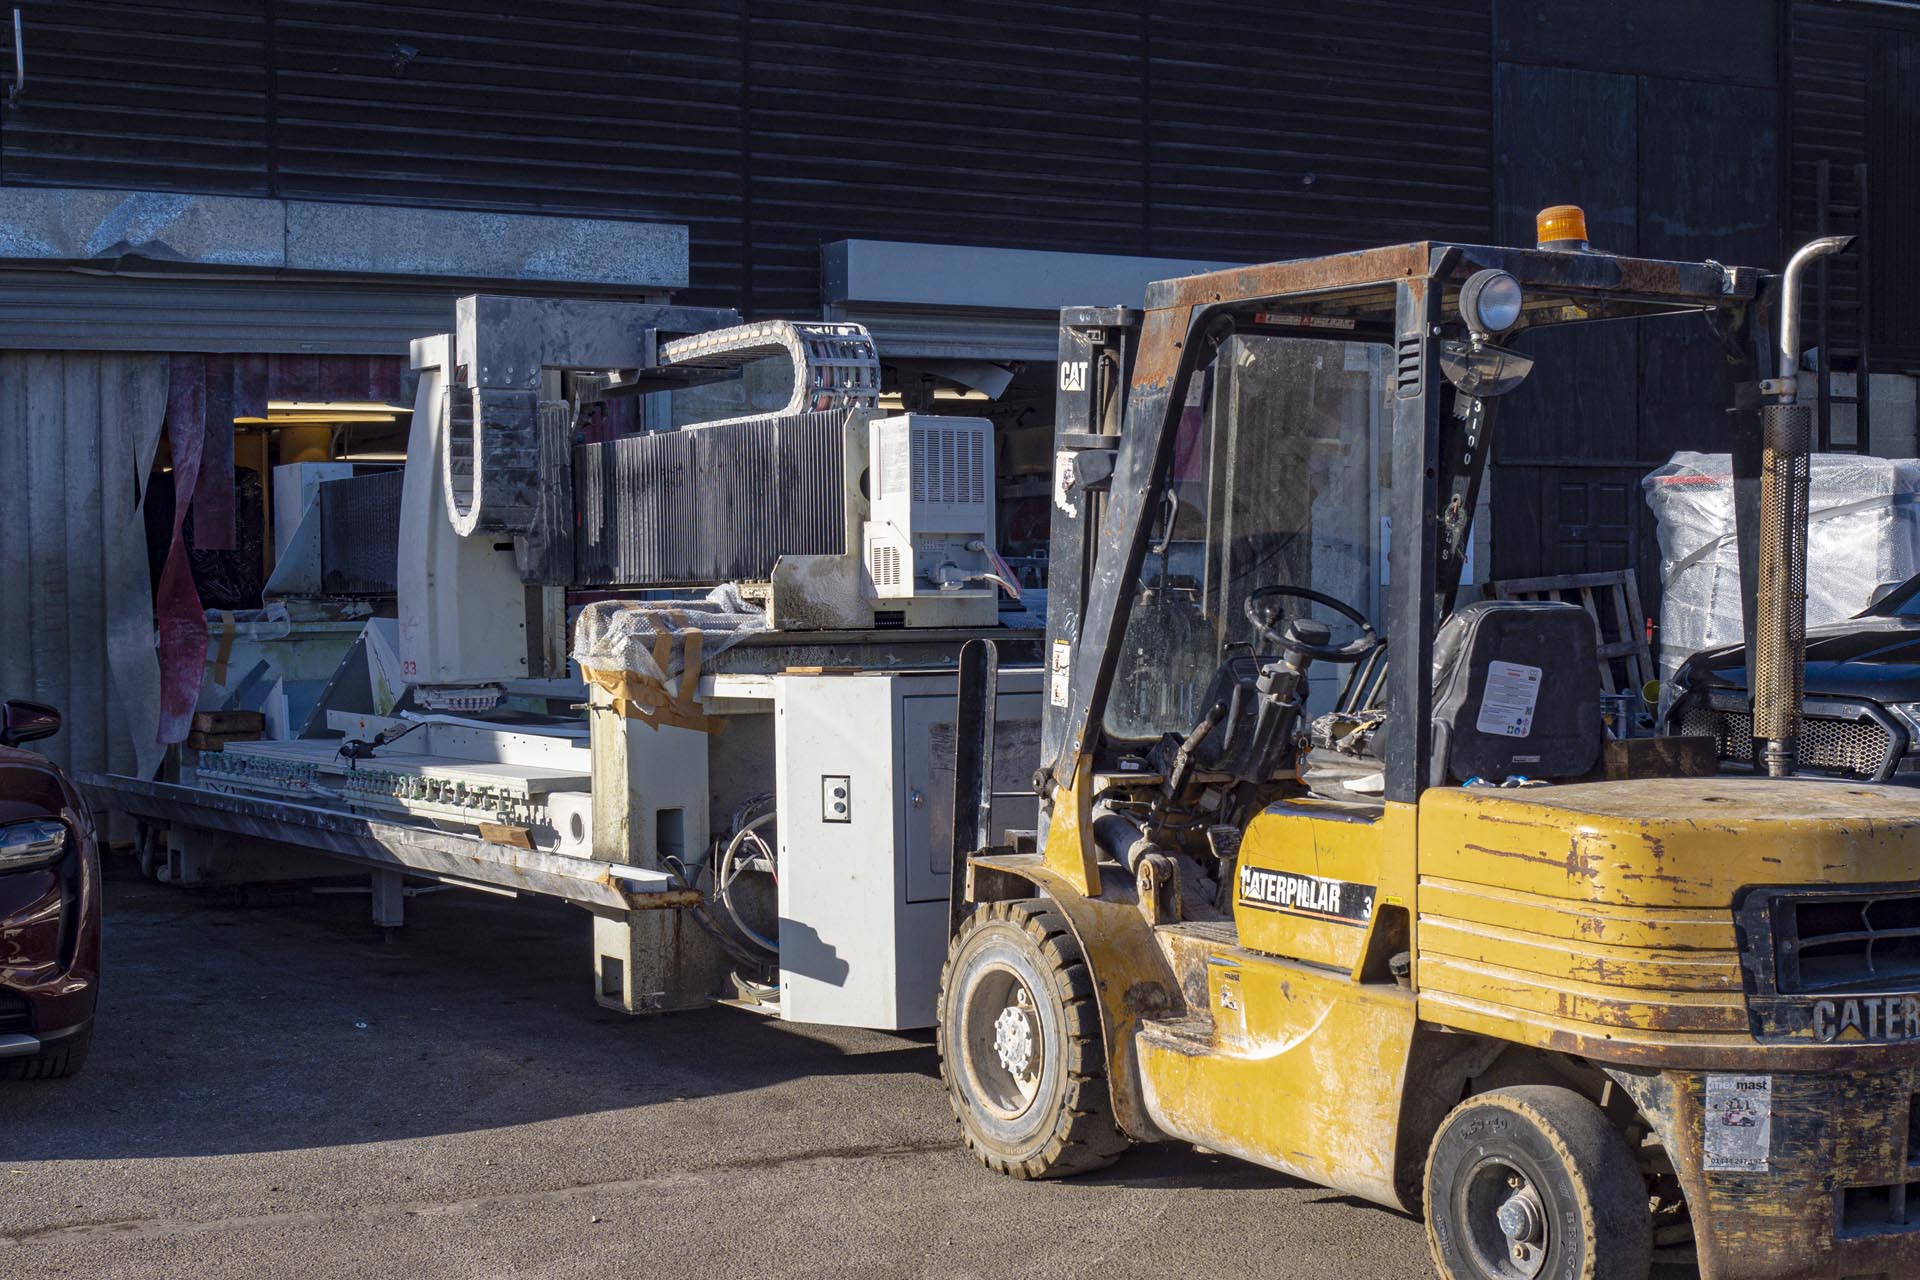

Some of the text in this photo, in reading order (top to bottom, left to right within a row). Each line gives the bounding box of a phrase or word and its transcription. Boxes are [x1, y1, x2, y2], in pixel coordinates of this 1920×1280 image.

[1060, 361, 1088, 391] CAT
[1463, 400, 1482, 465] 3100
[403, 660, 417, 675] 33
[1240, 866, 1373, 918] CATERPILLAR 3
[1813, 996, 1920, 1042] CATER
[1736, 1080, 1768, 1090] mast
